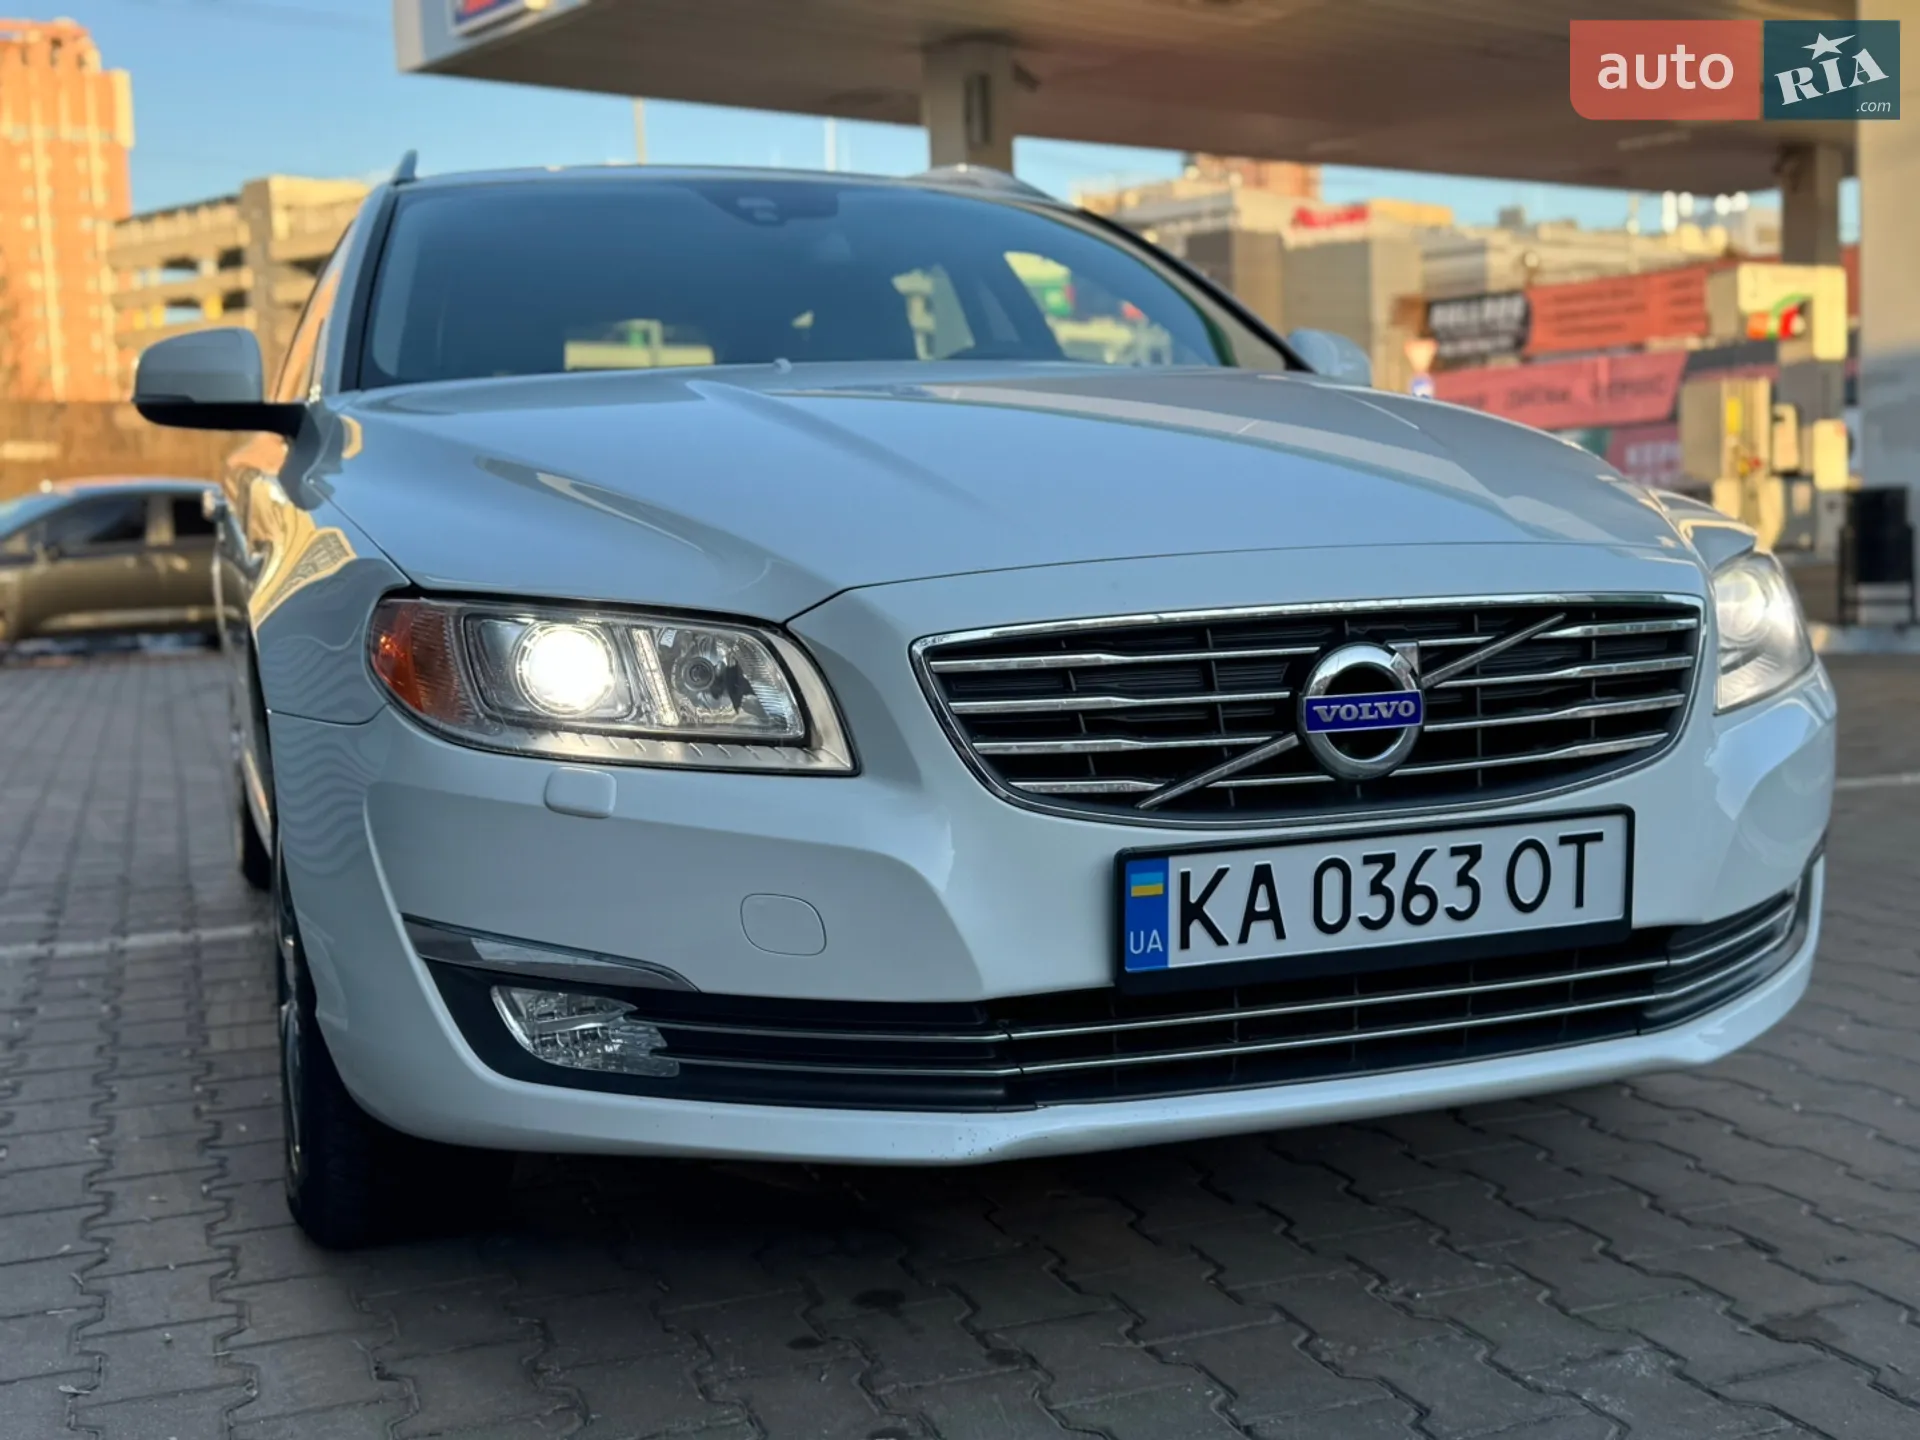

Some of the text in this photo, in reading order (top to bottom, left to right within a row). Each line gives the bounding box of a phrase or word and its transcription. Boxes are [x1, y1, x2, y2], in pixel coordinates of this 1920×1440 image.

[1312, 700, 1416, 723] VOLVO
[1179, 830, 1604, 950] KA 0363 OT
[1129, 928, 1164, 955] UA
